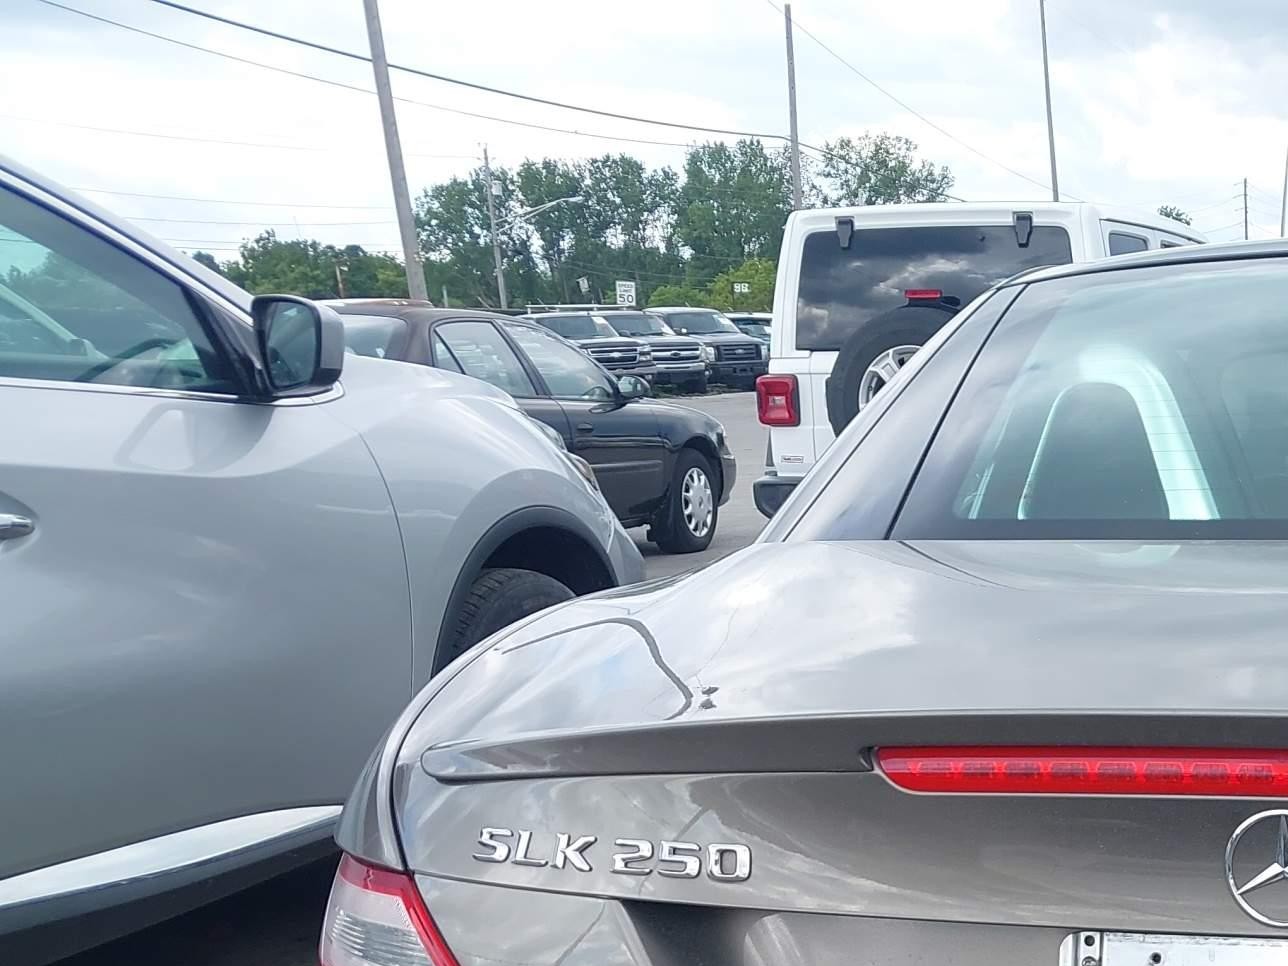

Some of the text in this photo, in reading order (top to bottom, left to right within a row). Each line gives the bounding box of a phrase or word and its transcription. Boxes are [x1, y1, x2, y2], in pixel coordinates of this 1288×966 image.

[618, 294, 634, 304] 50
[472, 827, 753, 882] SLK 250
